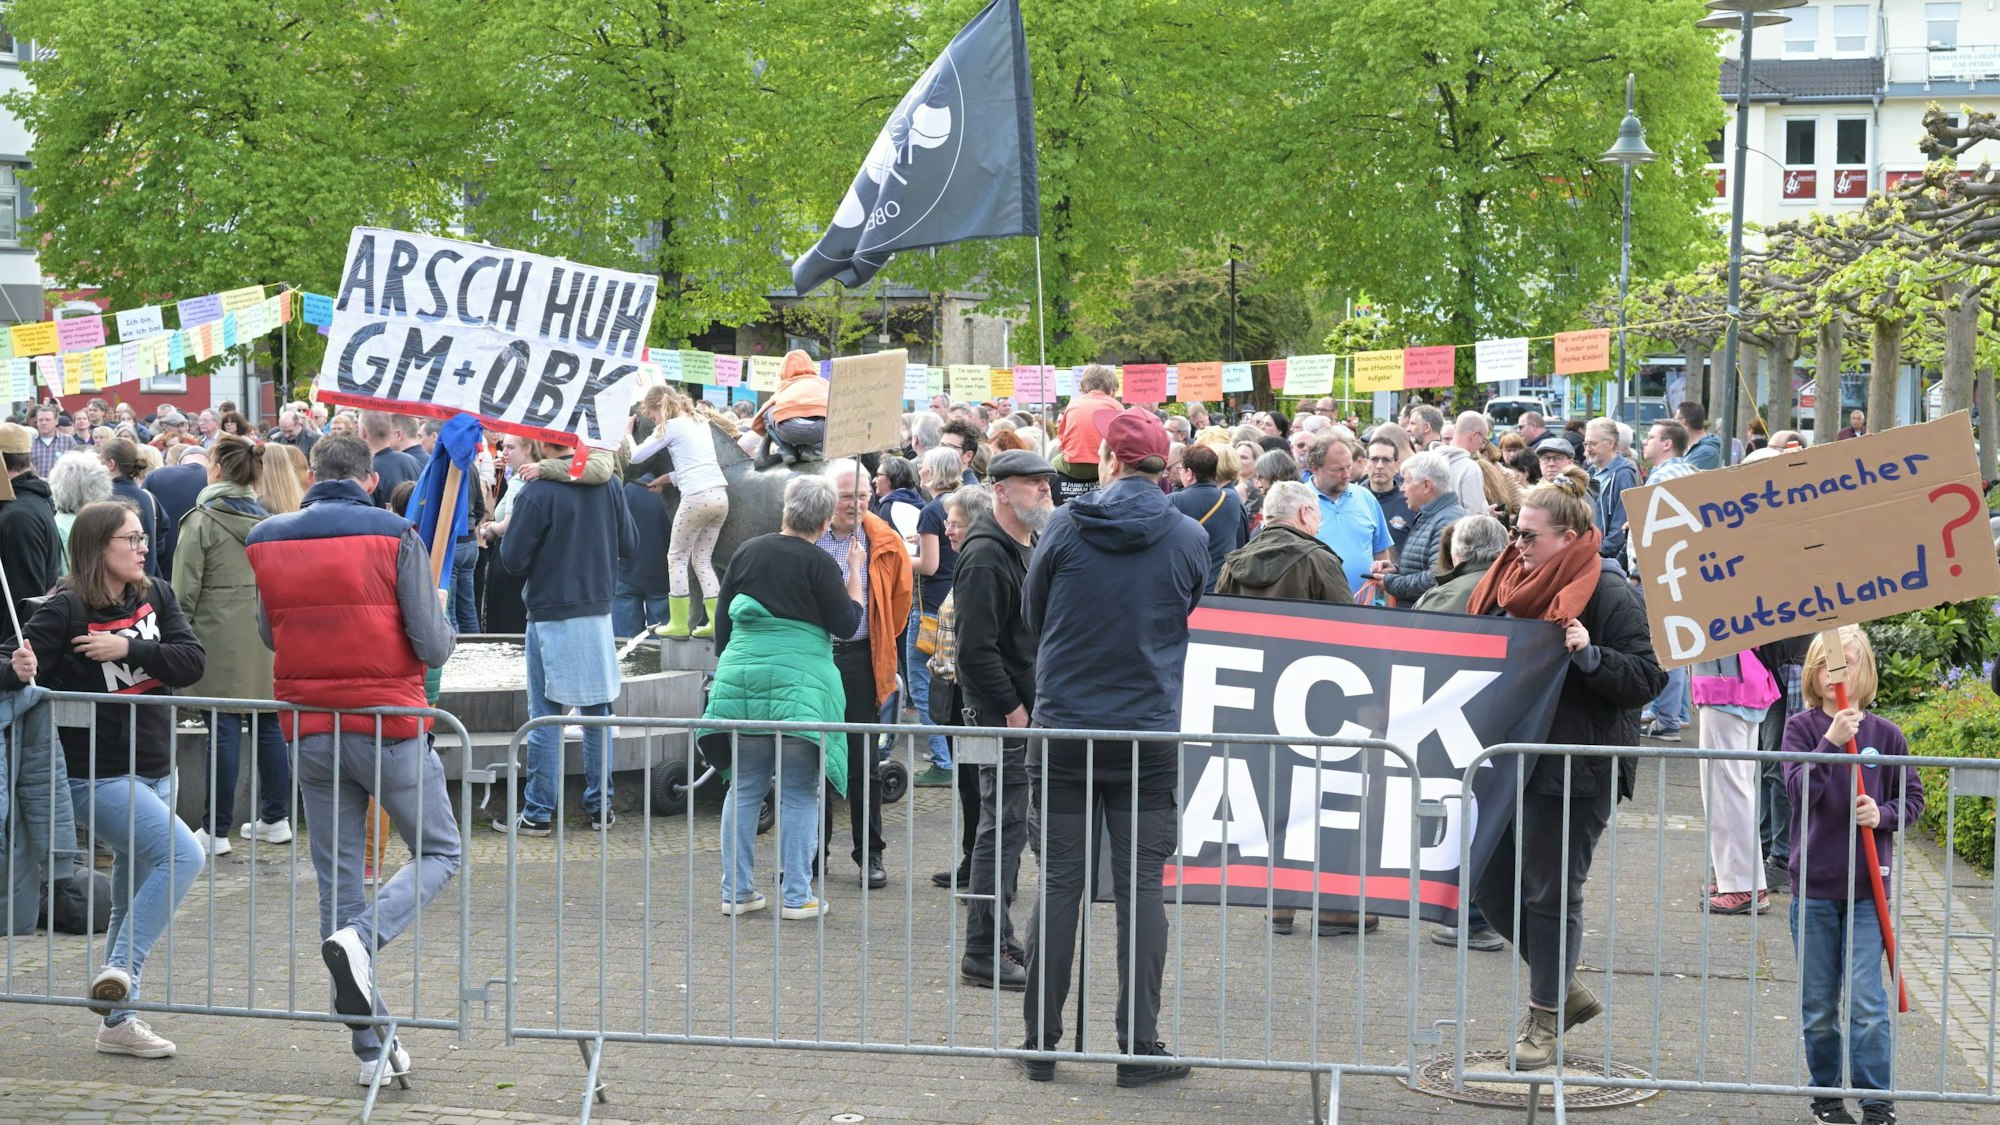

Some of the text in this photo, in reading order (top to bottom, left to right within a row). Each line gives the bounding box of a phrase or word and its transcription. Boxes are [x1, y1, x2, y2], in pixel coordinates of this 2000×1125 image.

[336, 234, 654, 358] ARSCH HUH
[1571, 334, 1606, 342] aufgeklärte
[1642, 454, 1930, 548] Angstmacher
[1656, 539, 1745, 602] für
[1180, 642, 1503, 770] FCK
[1174, 755, 1479, 872] AFD
